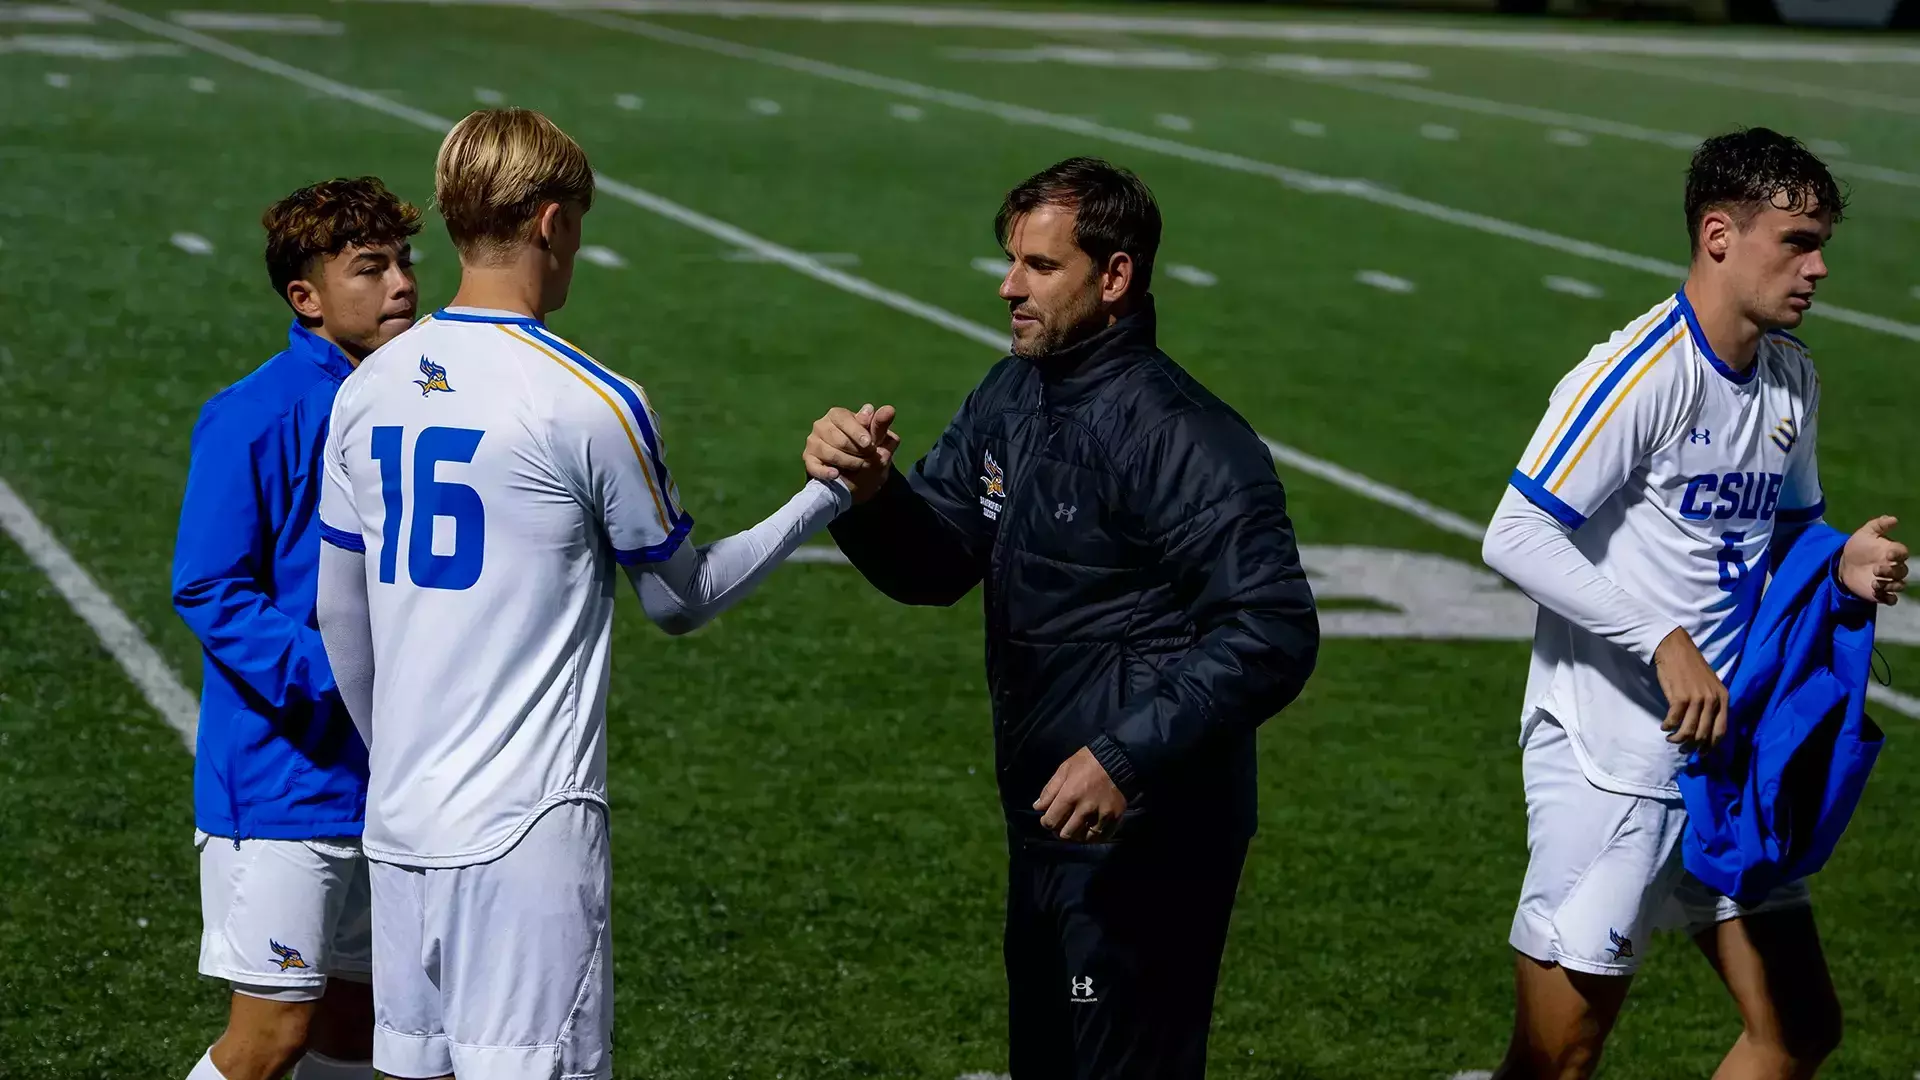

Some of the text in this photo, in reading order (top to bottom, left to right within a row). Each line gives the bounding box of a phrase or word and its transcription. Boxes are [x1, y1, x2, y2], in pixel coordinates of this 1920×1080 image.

[371, 426, 486, 590] 16
[1680, 472, 1783, 520] CSUB
[1717, 531, 1749, 592] 6
